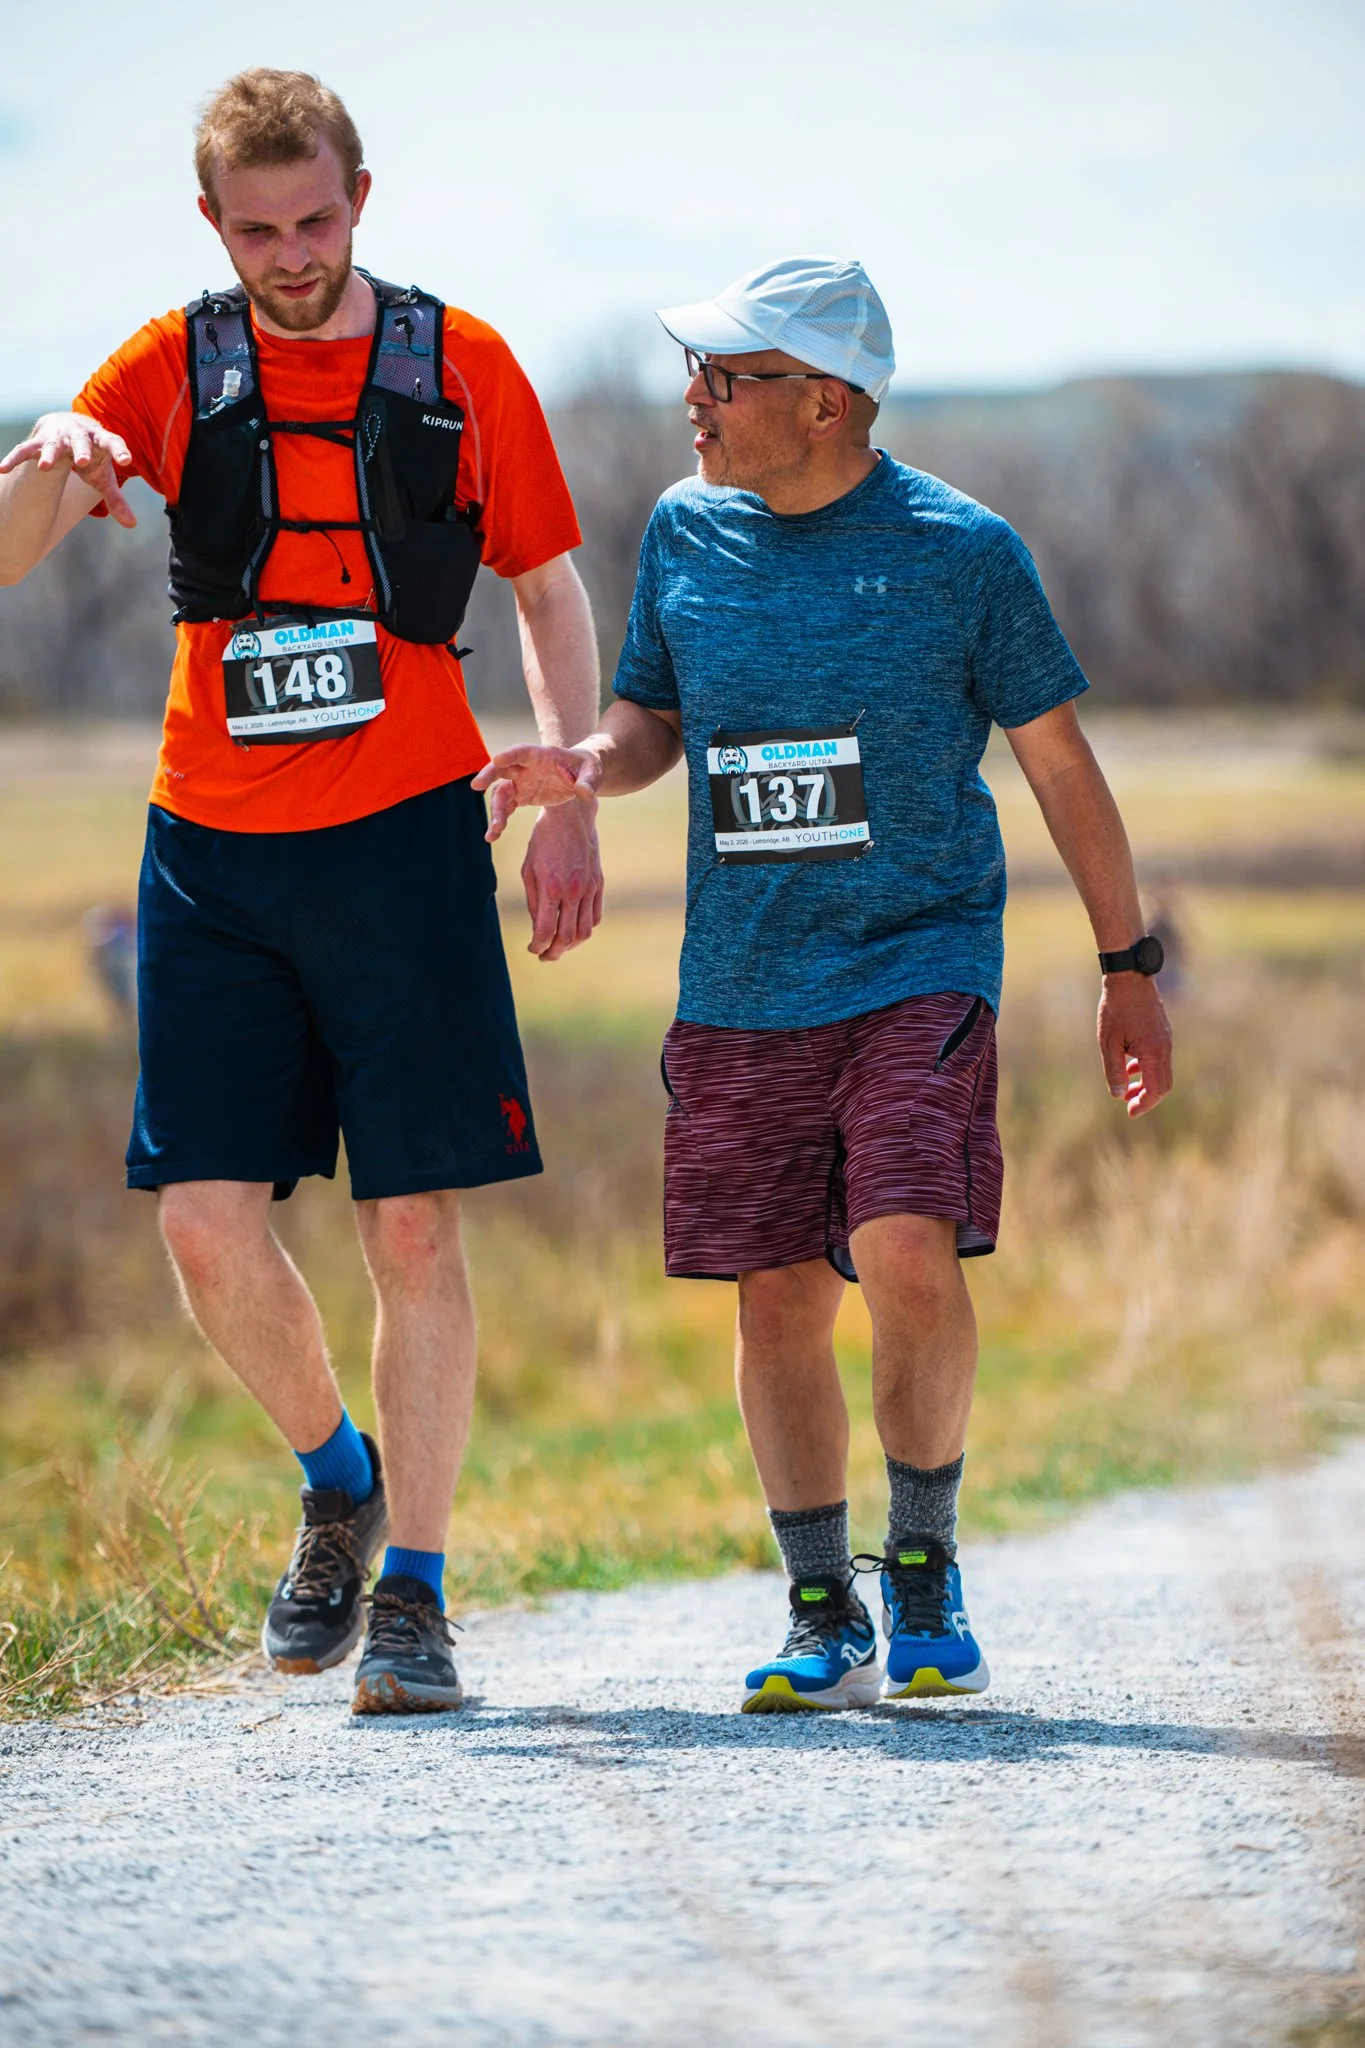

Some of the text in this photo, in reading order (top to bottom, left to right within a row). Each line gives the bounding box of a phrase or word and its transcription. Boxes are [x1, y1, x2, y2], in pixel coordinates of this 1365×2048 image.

[422, 414, 464, 431] KIPRUN
[274, 622, 355, 645] OLDMAN
[282, 638, 350, 653] BACKYARD ULTRA
[253, 654, 347, 706] 148
[761, 741, 838, 761] OLDMAN
[768, 758, 833, 769] BACKYARD ULTRA
[739, 774, 825, 824] 137
[720, 839, 730, 847] May
